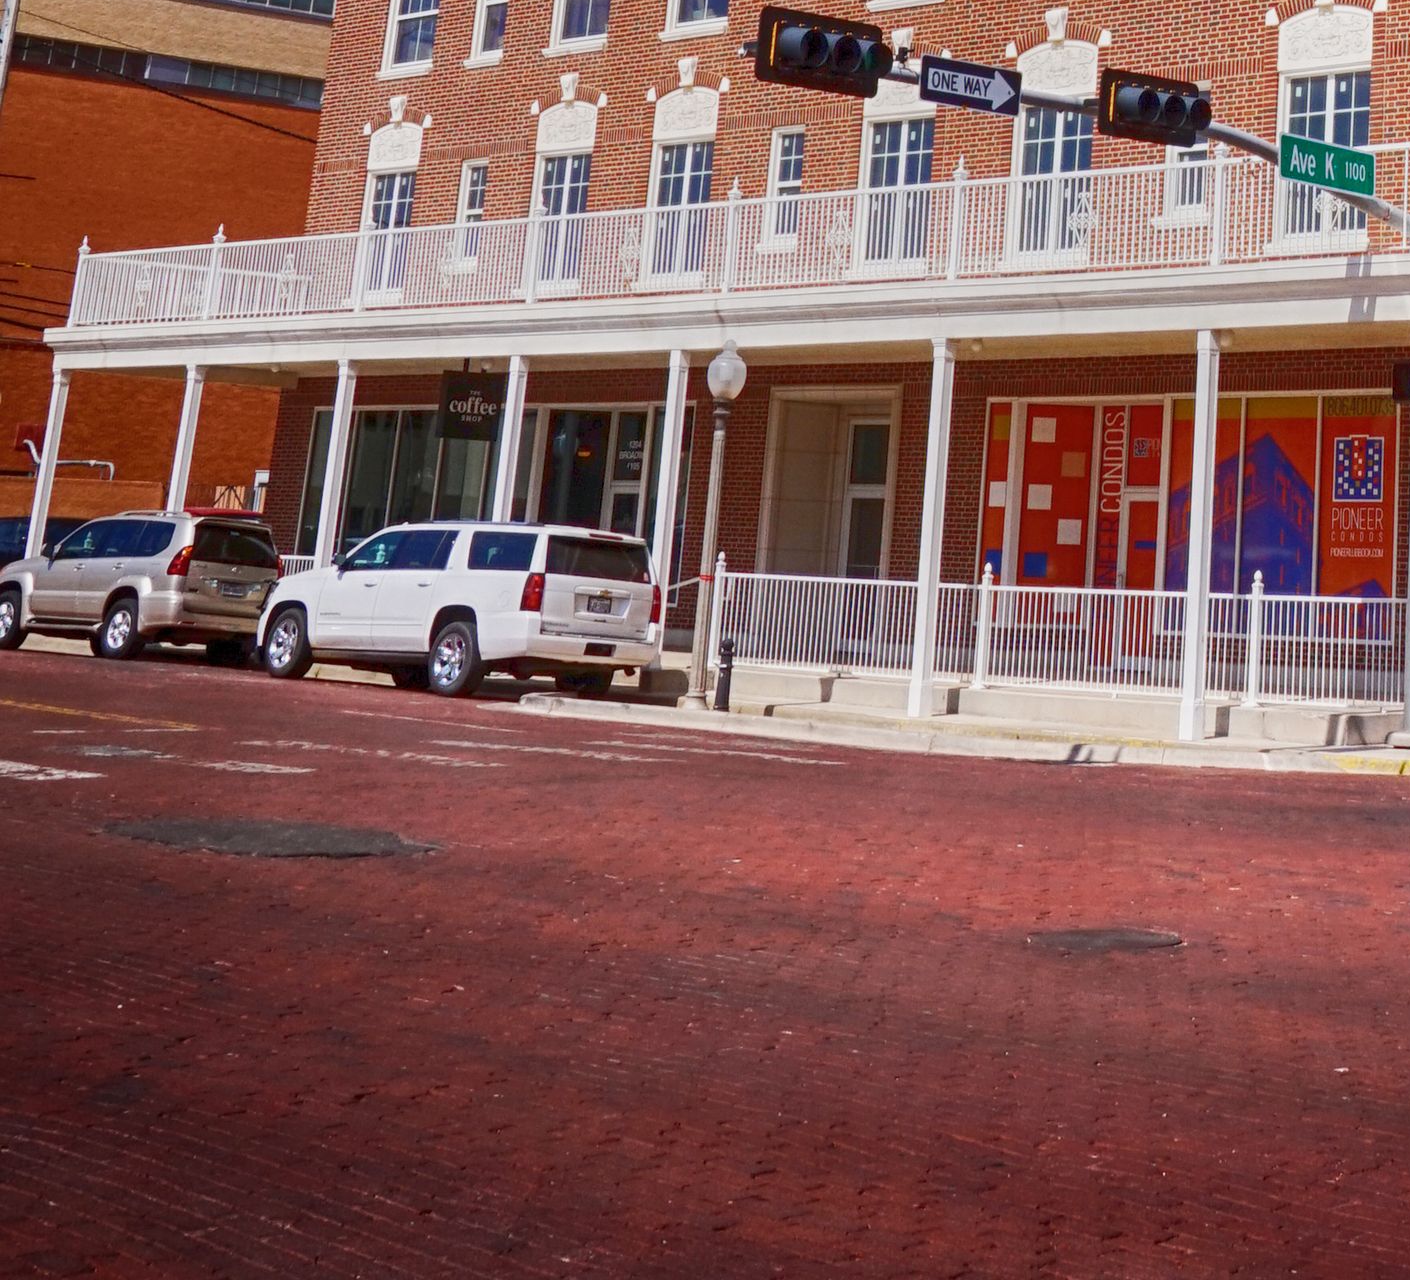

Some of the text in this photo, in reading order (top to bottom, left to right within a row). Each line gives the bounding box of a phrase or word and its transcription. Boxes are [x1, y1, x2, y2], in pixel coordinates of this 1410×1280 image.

[931, 71, 991, 97] ONE WAY
[1290, 144, 1366, 182] Ave K 1100
[449, 396, 497, 415] coffee
[461, 414, 482, 422] SHOP
[1101, 411, 1125, 512] CONDOS
[1331, 507, 1384, 531] PIONEER
[1331, 531, 1384, 543] CONDOS
